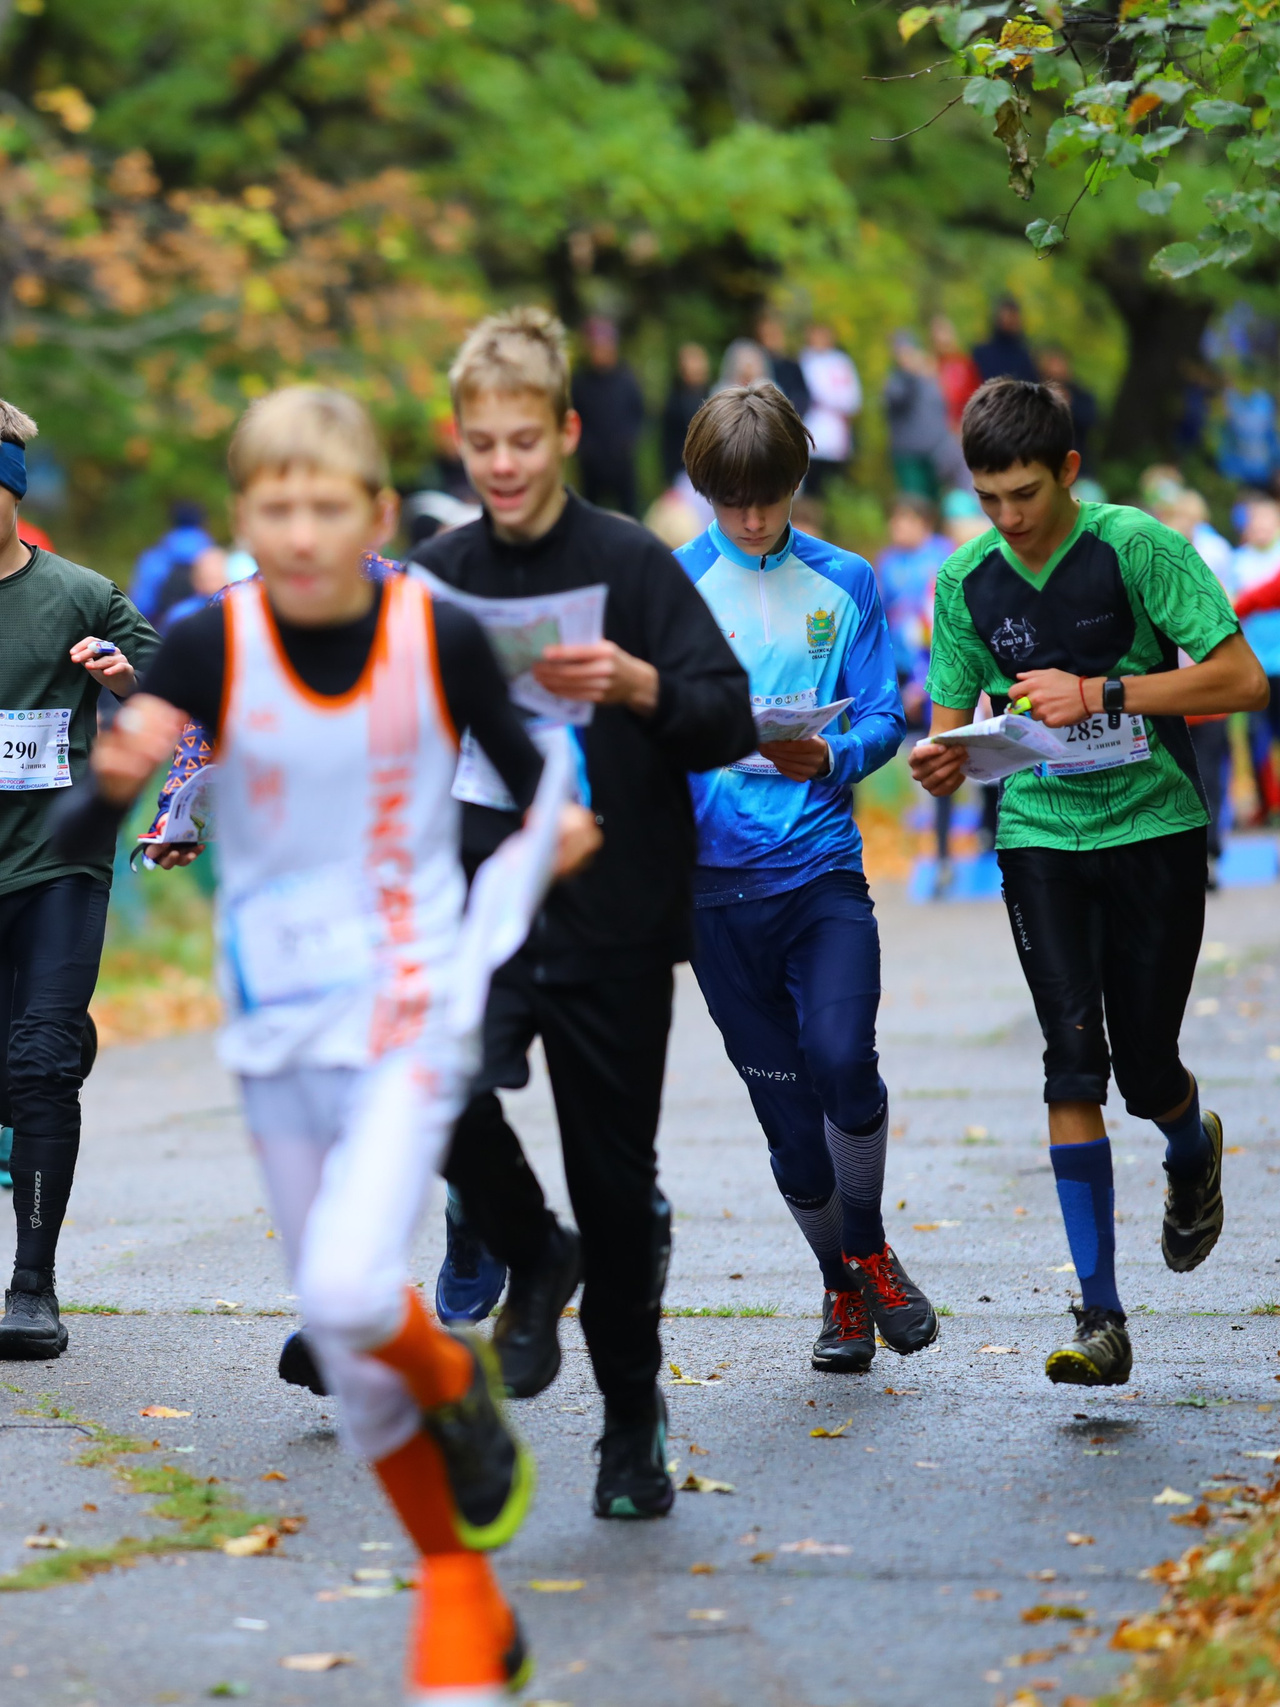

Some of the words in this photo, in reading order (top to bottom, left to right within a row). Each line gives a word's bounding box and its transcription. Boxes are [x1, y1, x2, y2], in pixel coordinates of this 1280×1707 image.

[1065, 719, 1104, 742] 285
[3, 741, 37, 760] 290
[1094, 739, 1121, 750] линия
[16, 782, 49, 790] СОРЕВНОВАНИЯ
